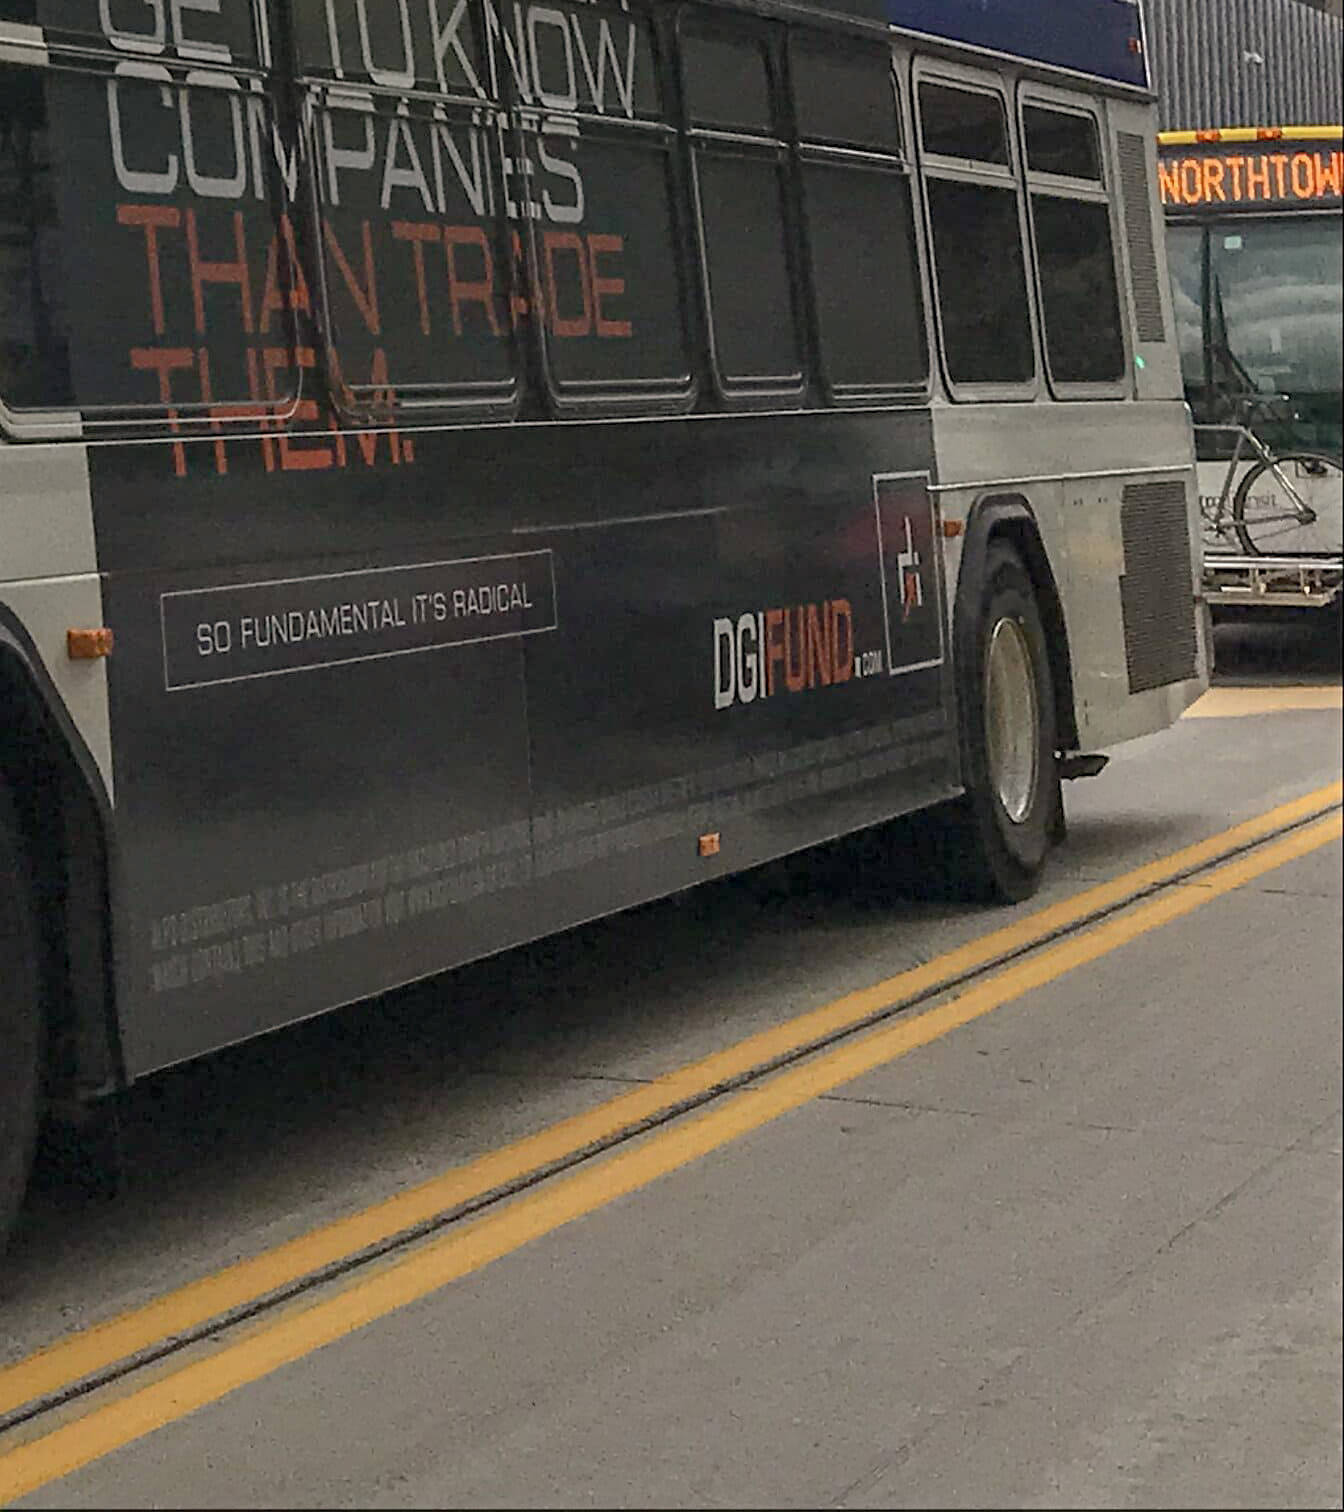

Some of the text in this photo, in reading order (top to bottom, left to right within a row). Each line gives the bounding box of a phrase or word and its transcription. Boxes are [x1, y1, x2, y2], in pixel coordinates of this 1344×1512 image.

[107, 61, 585, 224] COMPANIES
[115, 204, 633, 338] THAN TRADE
[196, 582, 534, 656] SO FUNDAMENTAL IT'S RADICAL
